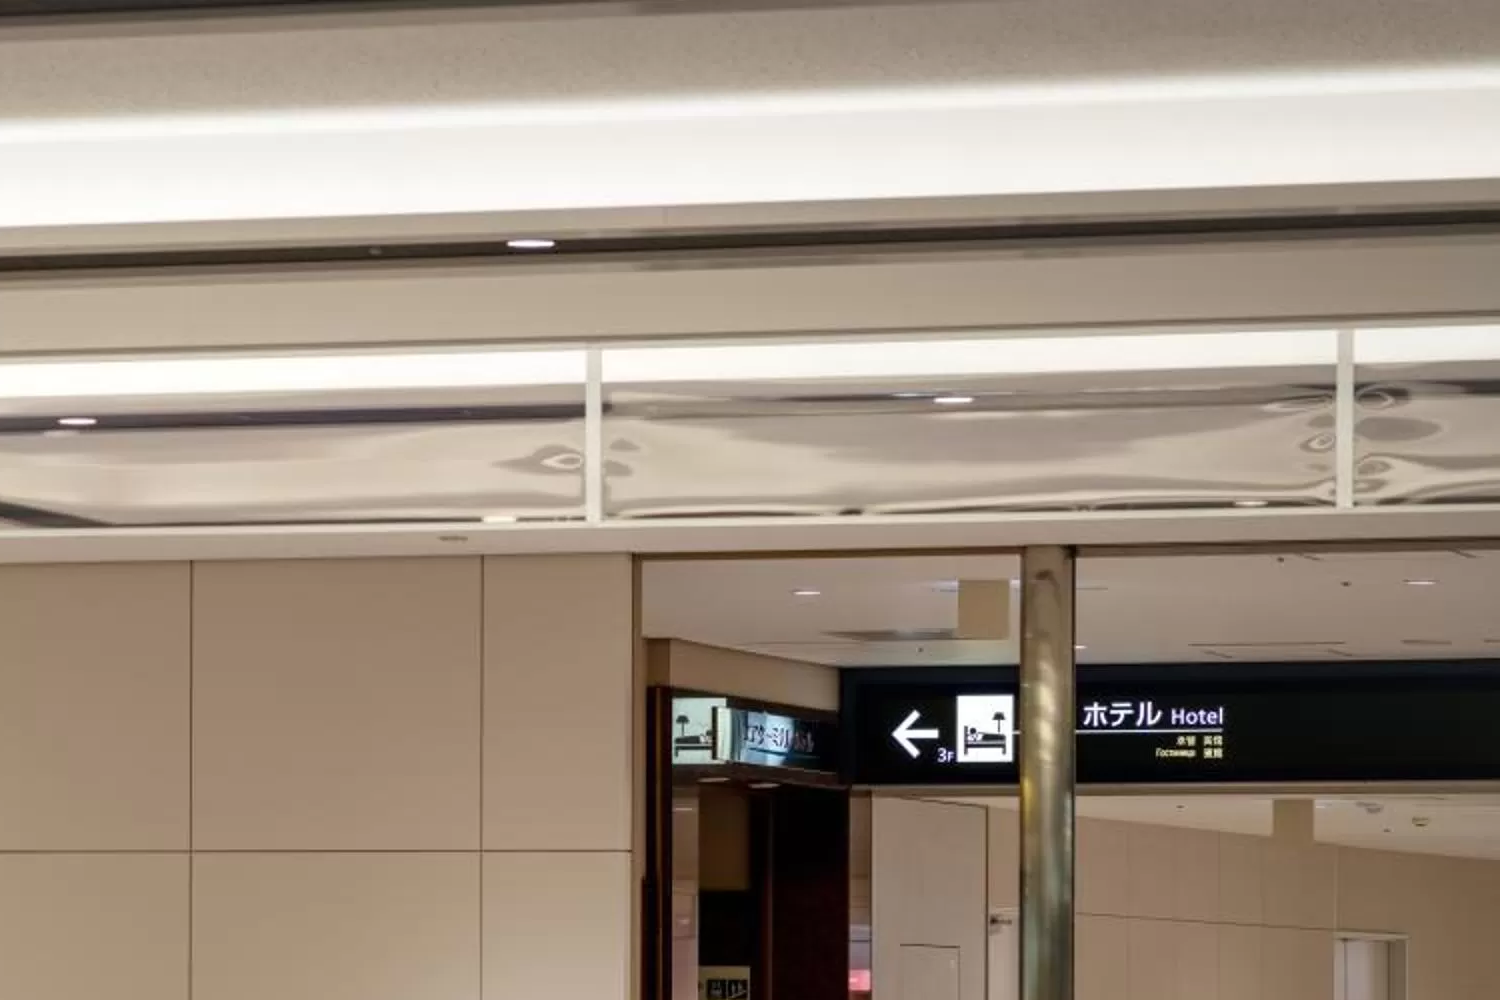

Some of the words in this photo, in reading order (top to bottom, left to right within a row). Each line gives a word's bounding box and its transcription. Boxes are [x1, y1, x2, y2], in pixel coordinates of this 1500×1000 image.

[1083, 702, 1163, 727] ホテル
[1171, 707, 1223, 725] Hotel
[937, 747, 955, 763] 3F
